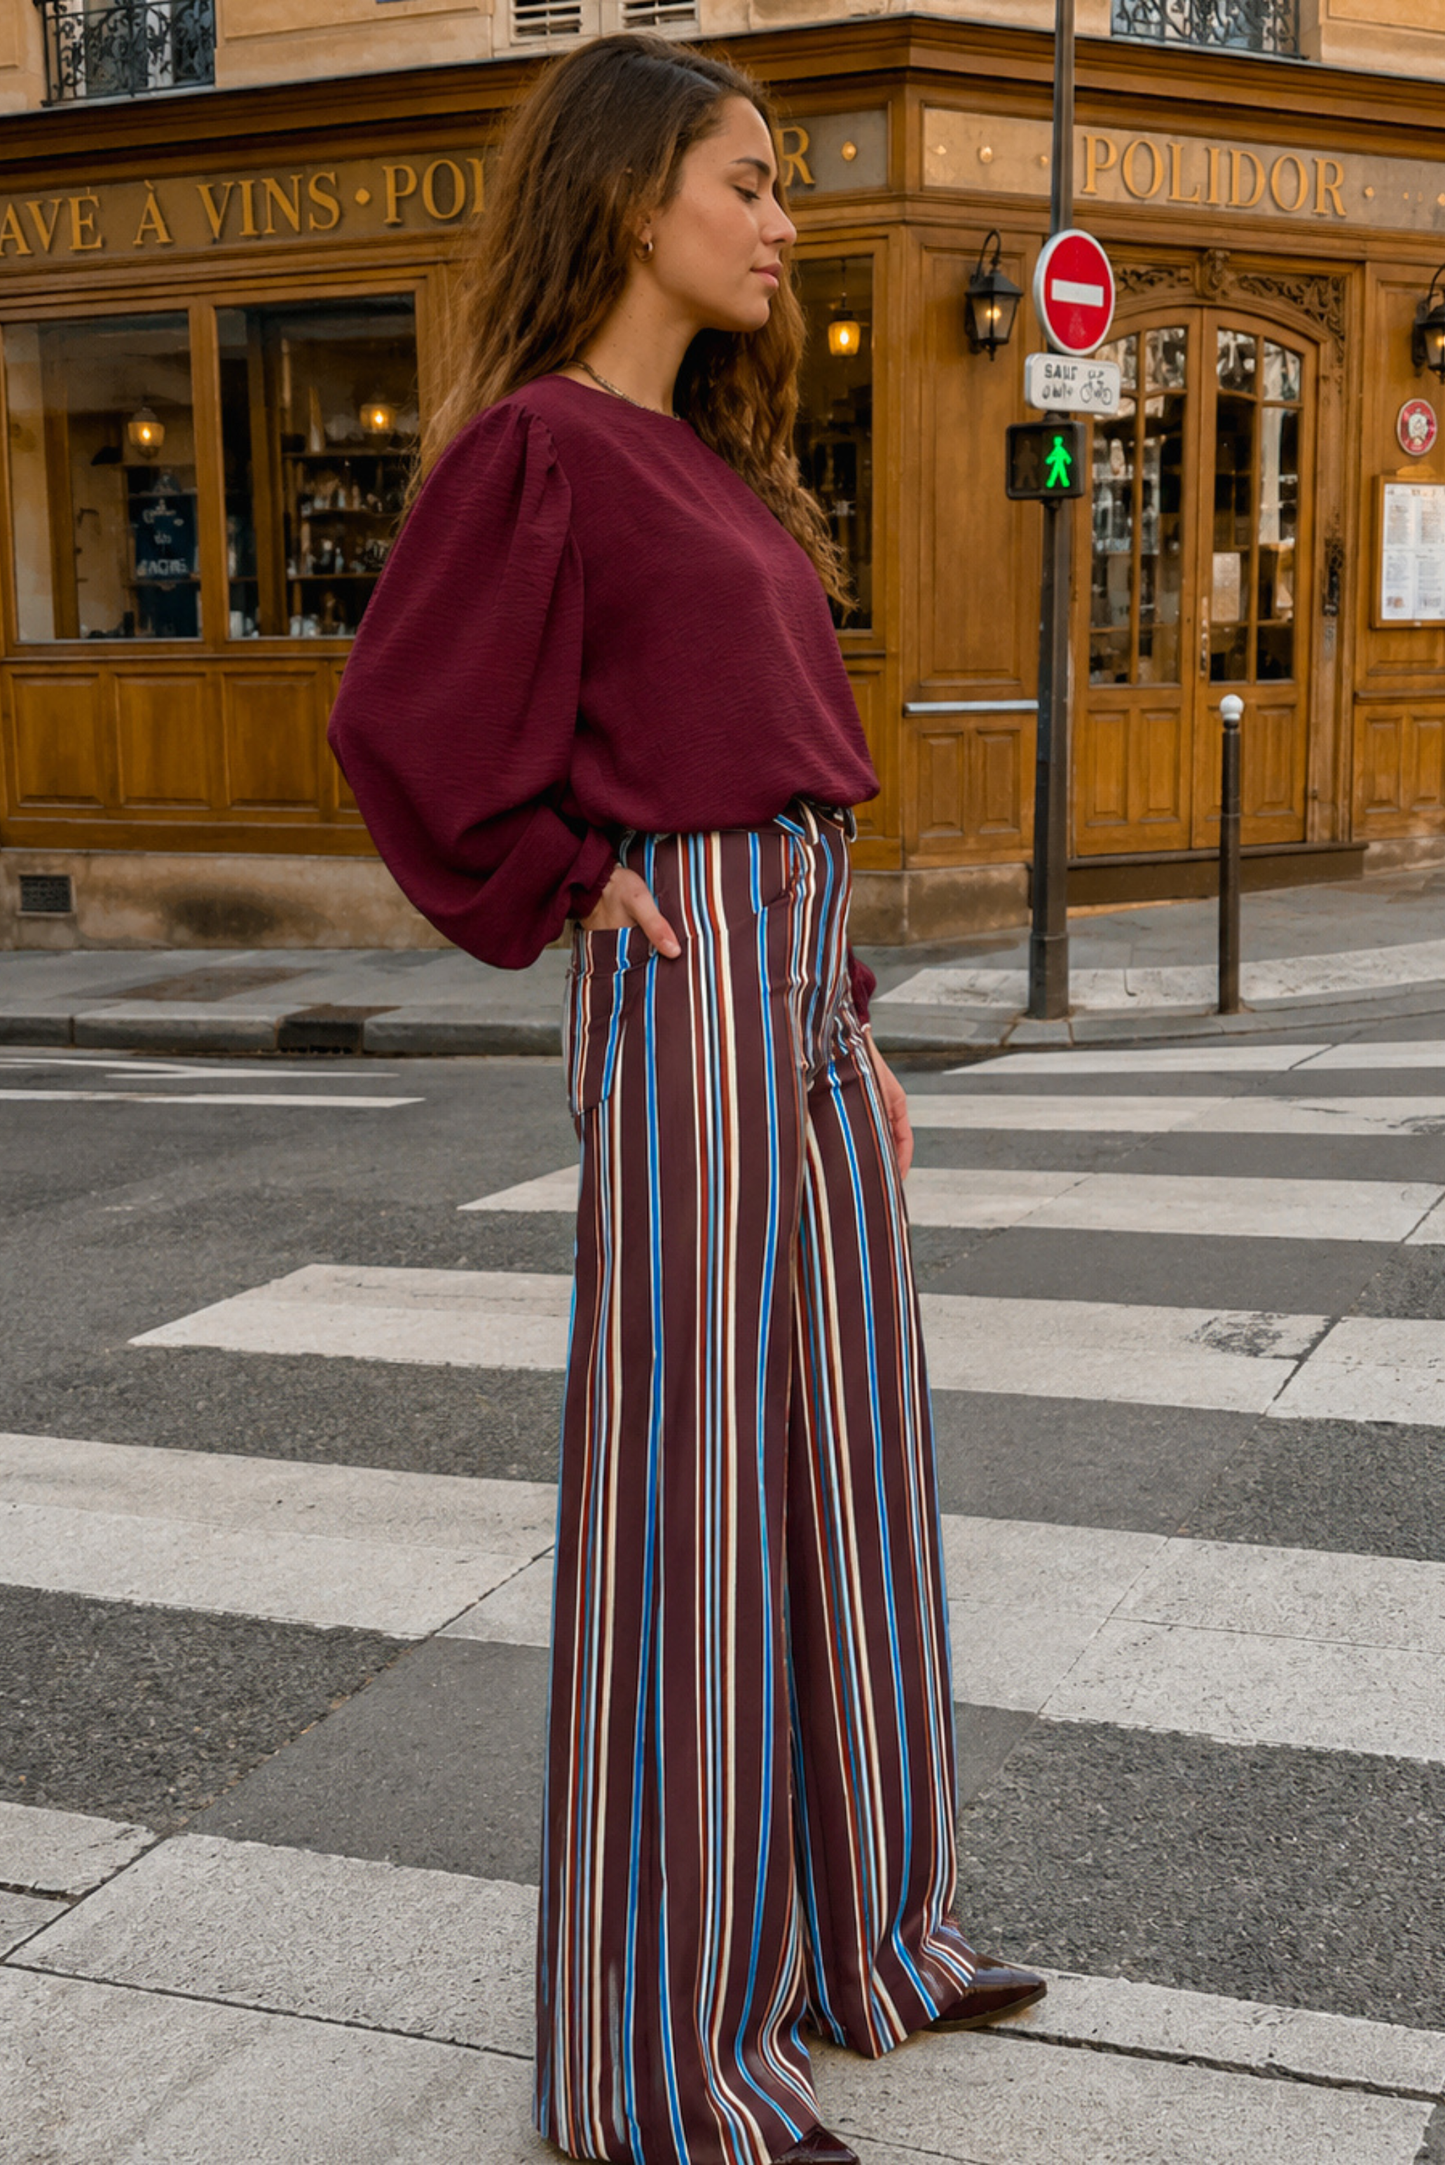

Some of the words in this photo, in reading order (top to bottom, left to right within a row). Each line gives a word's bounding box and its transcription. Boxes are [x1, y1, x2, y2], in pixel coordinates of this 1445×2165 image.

[133, 179, 173, 245] À
[196, 171, 341, 239] VINS
[1081, 134, 1347, 217] POLIDOR
